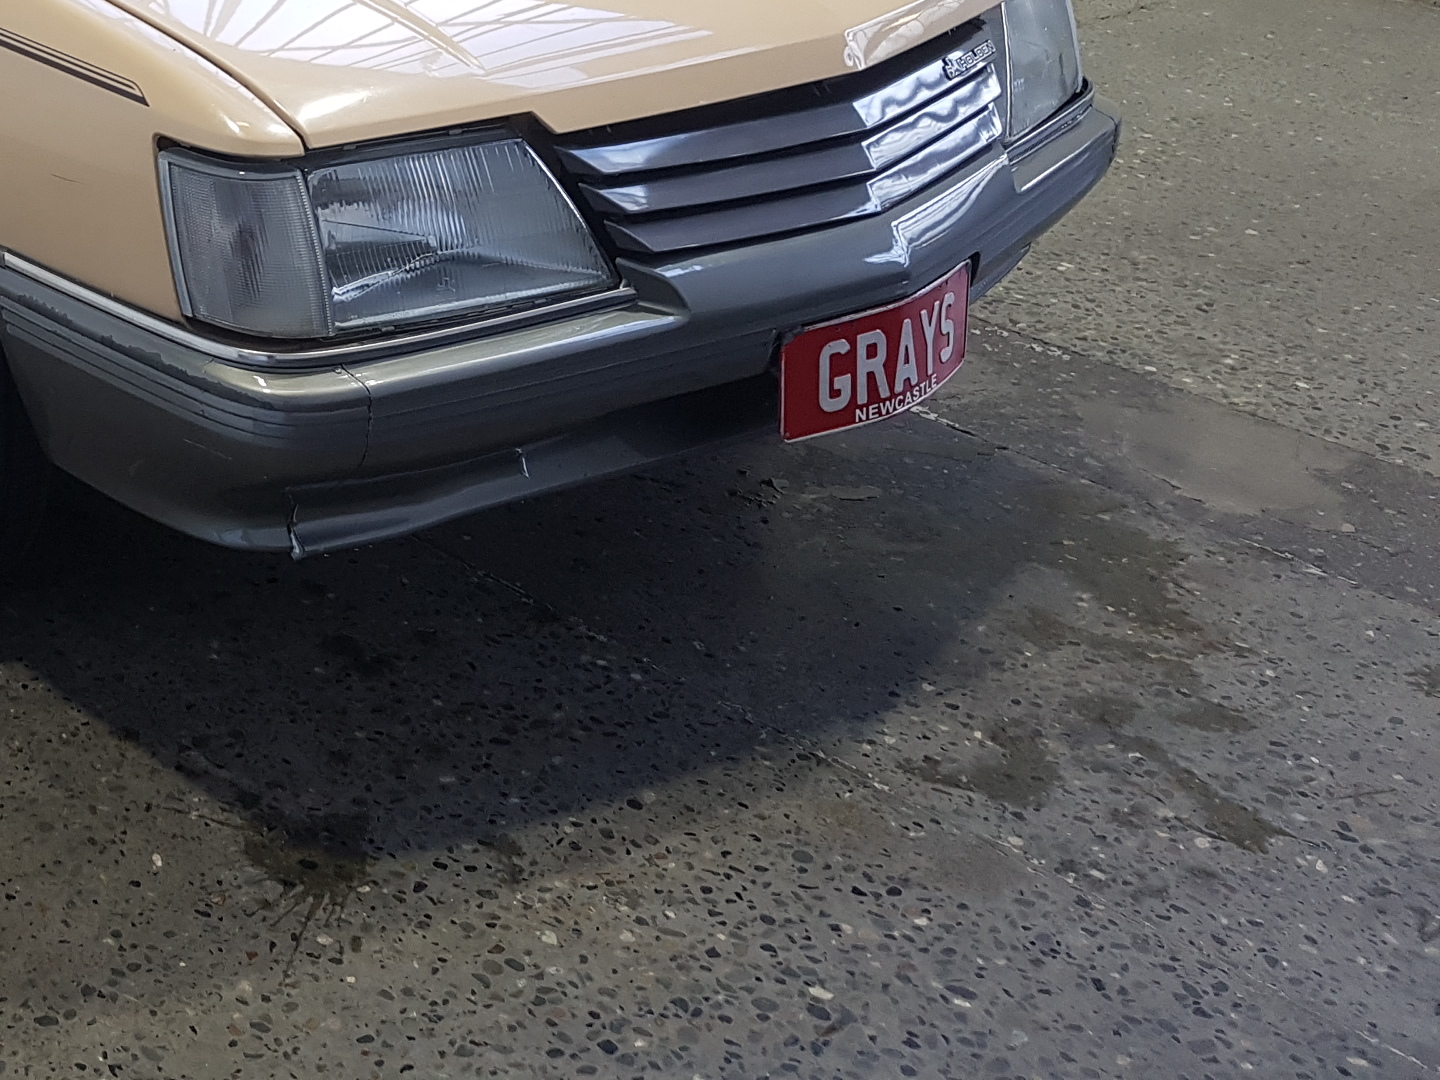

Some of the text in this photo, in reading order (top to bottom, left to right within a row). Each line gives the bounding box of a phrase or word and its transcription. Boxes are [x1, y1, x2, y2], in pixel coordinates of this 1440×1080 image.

[956, 39, 997, 71] HOLDEN
[818, 291, 956, 413] GRAYS
[855, 373, 938, 423] NEWCASTLE
